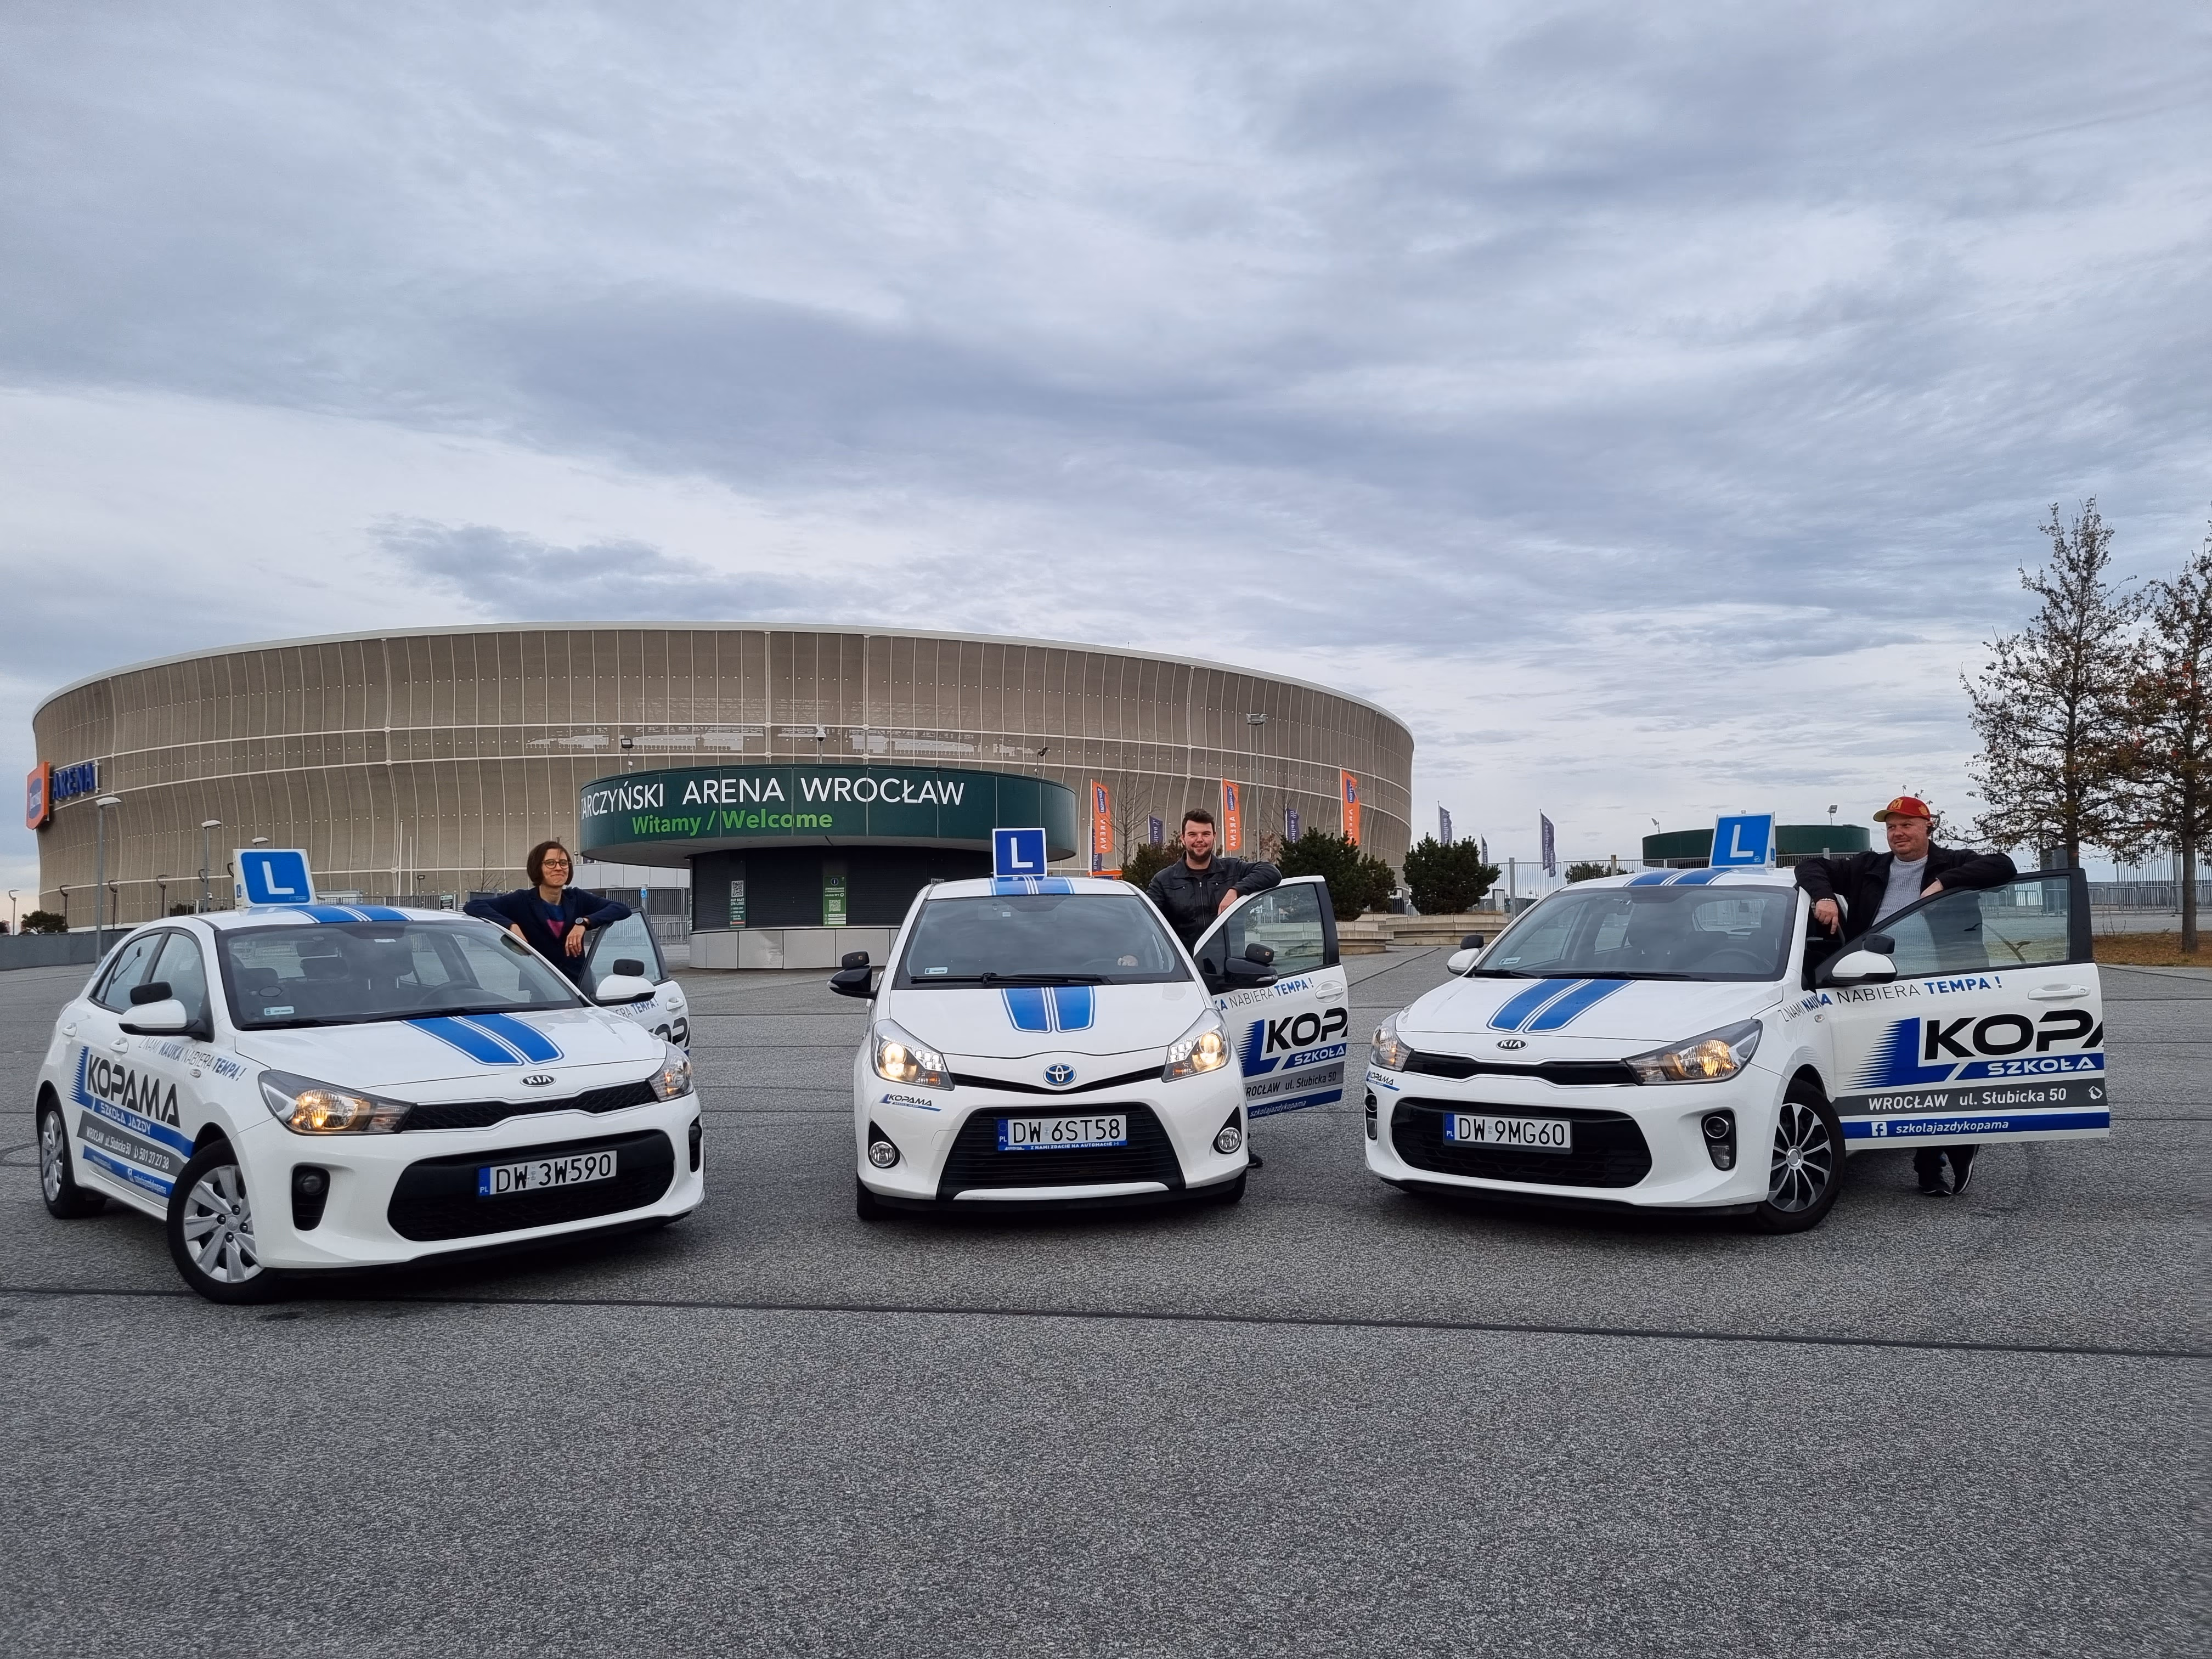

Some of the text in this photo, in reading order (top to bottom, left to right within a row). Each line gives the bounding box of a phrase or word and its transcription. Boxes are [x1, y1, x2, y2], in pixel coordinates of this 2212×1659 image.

[53, 763, 96, 801] ARENA
[682, 777, 785, 805] ARENA
[800, 777, 964, 805] WROCŁAW
[632, 814, 702, 836] Witamy
[722, 809, 833, 829] Welcome
[1011, 837, 1034, 868] L
[1730, 824, 1754, 858] L
[262, 861, 295, 894] L
[1229, 988, 1275, 1008] NABIERA
[1783, 1001, 1805, 1020] NAMI
[1836, 984, 1921, 1005] NABIERA
[1266, 1007, 1348, 1053] KOP
[1500, 1039, 1522, 1048] KIA
[159, 1041, 184, 1061] NAUKA
[181, 1048, 215, 1069] NABIERA
[1294, 1048, 1345, 1065] SZKOŁA
[1987, 1057, 2096, 1076] SZKOŁA
[88, 1054, 181, 1129] KOPAMA
[525, 1076, 551, 1085] KIA
[1245, 1071, 1336, 1097] ROCŁAW ul. Słubicka 50
[888, 1094, 932, 1107] KOPAMA
[1868, 1088, 2067, 1110] WROCŁAW ul. Słubicka 50
[101, 1102, 151, 1135] SZKOŁA JAZDY
[1013, 1118, 1120, 1143] DW 6ST58
[1459, 1118, 1565, 1146] DW 9MG60
[1896, 1120, 2009, 1135] szkolajazdykopama
[125, 1142, 131, 1155] 50
[139, 1148, 148, 1162] 501
[148, 1152, 156, 1165] 37
[155, 1154, 163, 1167] 27
[162, 1156, 170, 1170] 38
[496, 1154, 611, 1193] DW 3W590
